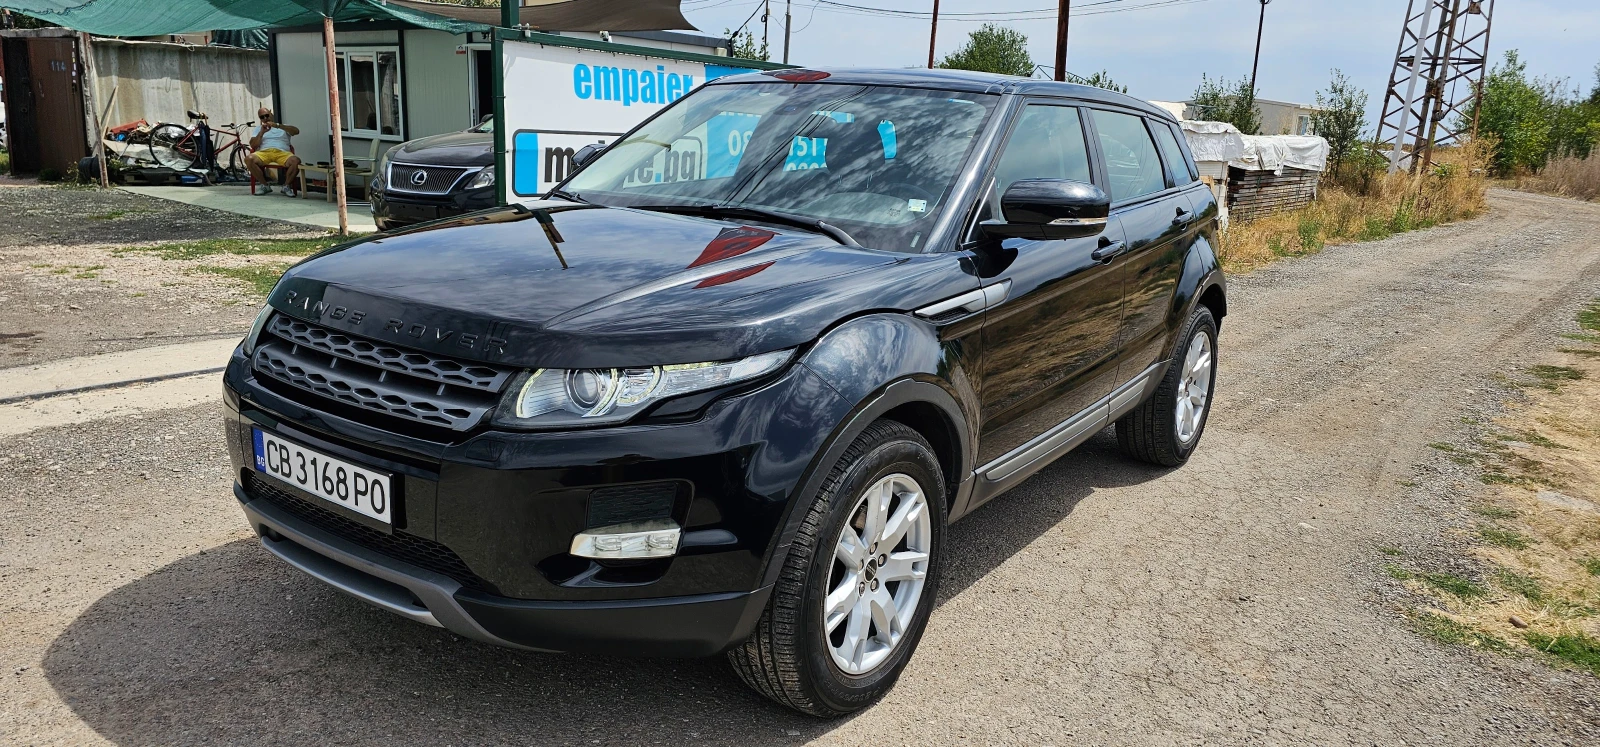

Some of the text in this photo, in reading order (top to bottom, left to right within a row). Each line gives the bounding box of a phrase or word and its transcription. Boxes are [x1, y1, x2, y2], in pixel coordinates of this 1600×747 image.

[573, 63, 693, 106] empaier
[285, 290, 508, 355] RANGE ROVER
[256, 454, 265, 467] BG
